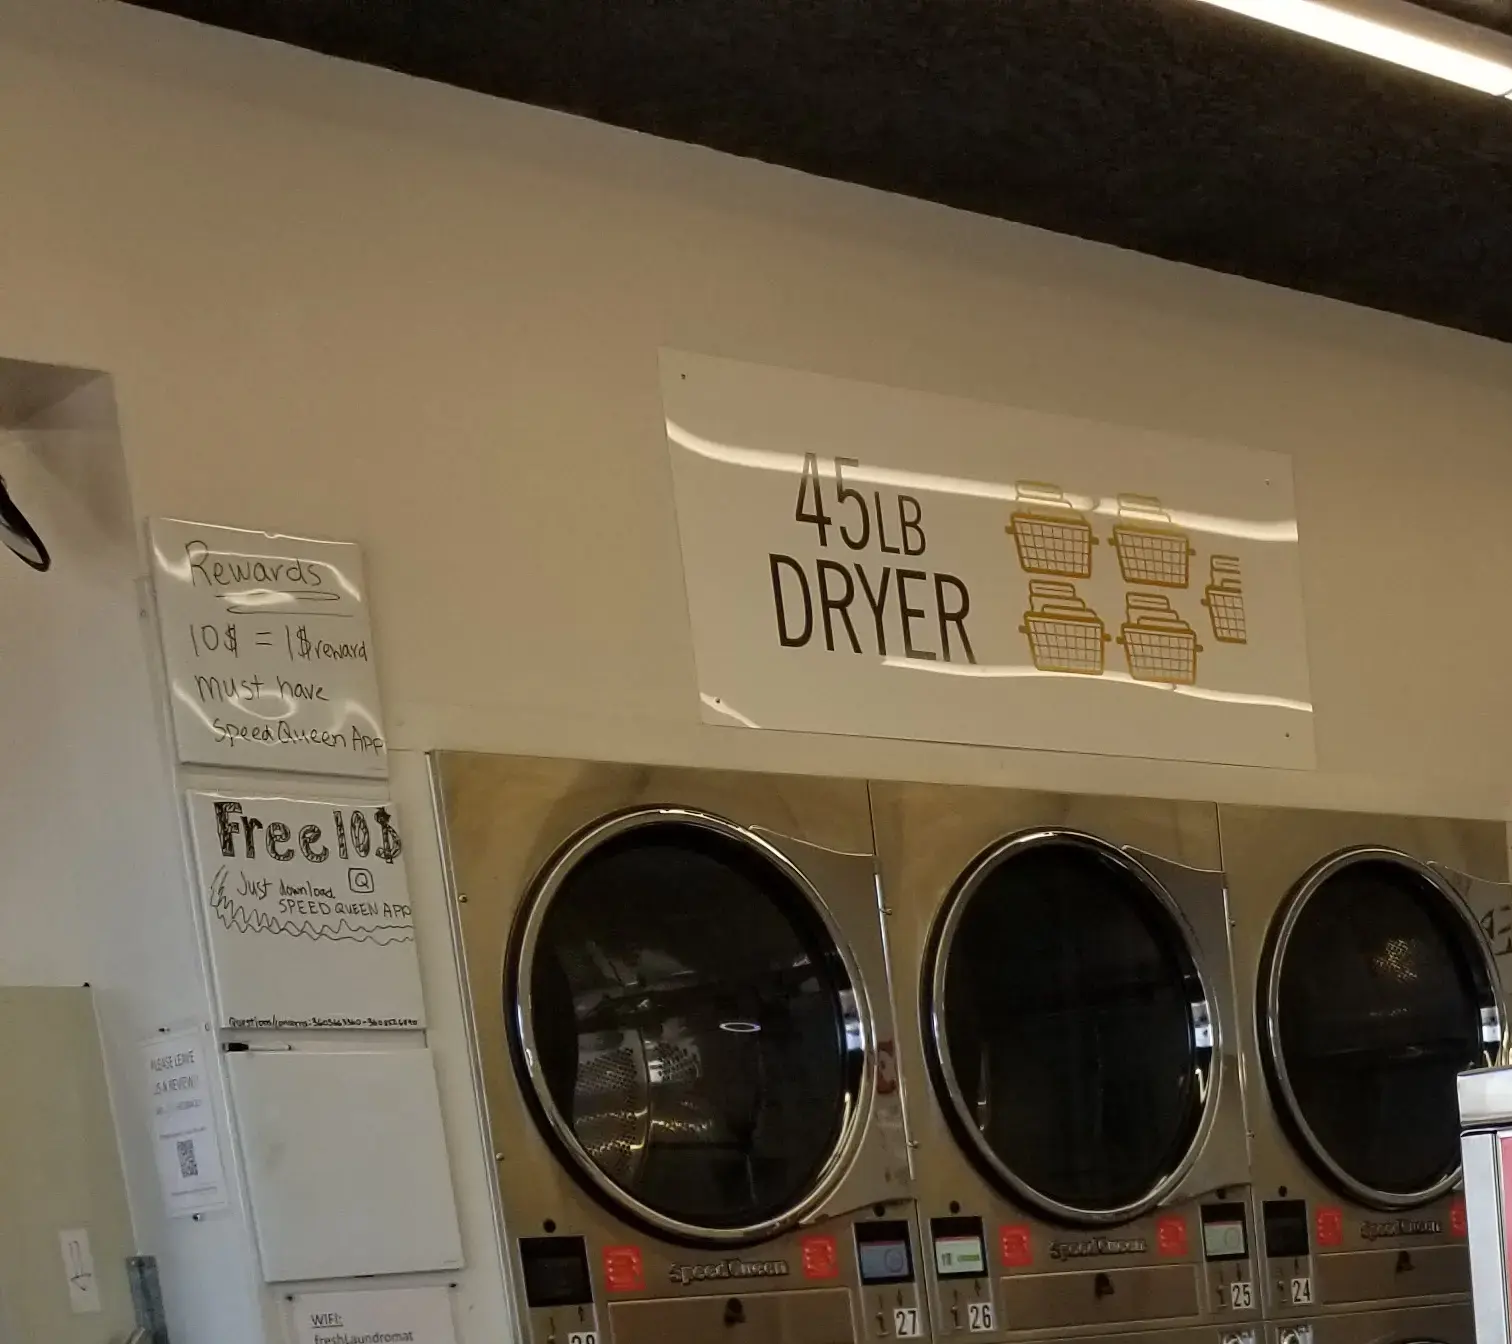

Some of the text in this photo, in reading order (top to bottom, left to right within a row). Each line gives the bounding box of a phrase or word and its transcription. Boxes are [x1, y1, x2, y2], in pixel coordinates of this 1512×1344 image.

[794, 452, 927, 558] 45LB
[186, 540, 322, 585] Rewards
[769, 553, 977, 664] DRYER
[190, 624, 237, 657] 10$
[277, 675, 329, 700] have
[214, 802, 329, 863] Free
[237, 871, 272, 899] Just
[279, 900, 330, 915] SPEED
[1233, 1284, 1251, 1307] 25
[1293, 1280, 1310, 1301] 24
[896, 1309, 917, 1335] 27
[971, 1305, 991, 1329] 26
